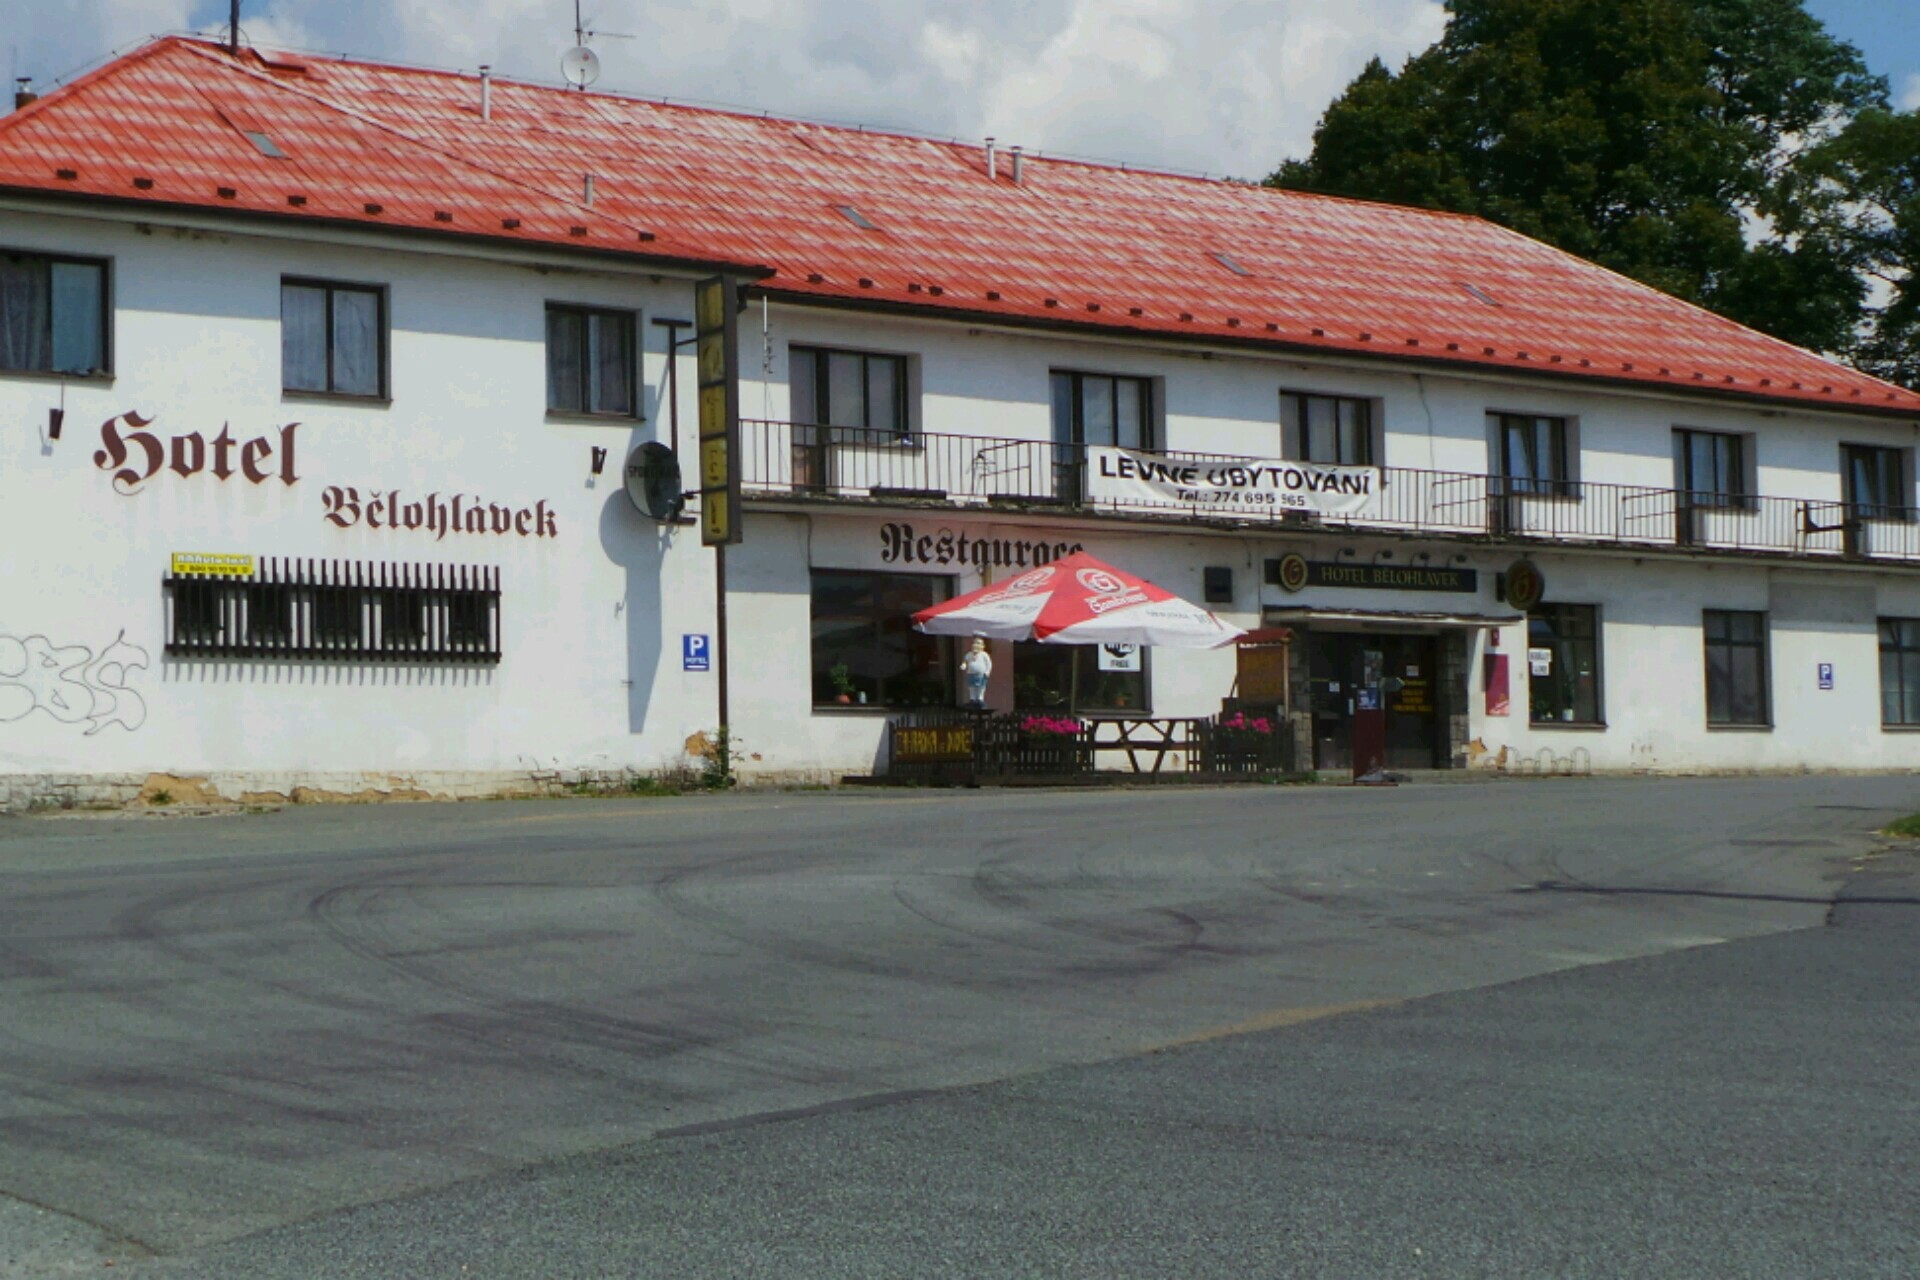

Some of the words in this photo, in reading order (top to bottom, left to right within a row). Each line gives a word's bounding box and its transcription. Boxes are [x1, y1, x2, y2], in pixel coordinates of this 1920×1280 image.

[93, 410, 302, 496] Hotel
[1213, 491, 1239, 503] 774
[1244, 491, 1275, 504] 695
[321, 485, 558, 541] Bělohlávek
[1321, 566, 1367, 583] HOTEL
[690, 636, 704, 657] P
[1820, 665, 1830, 680] P
